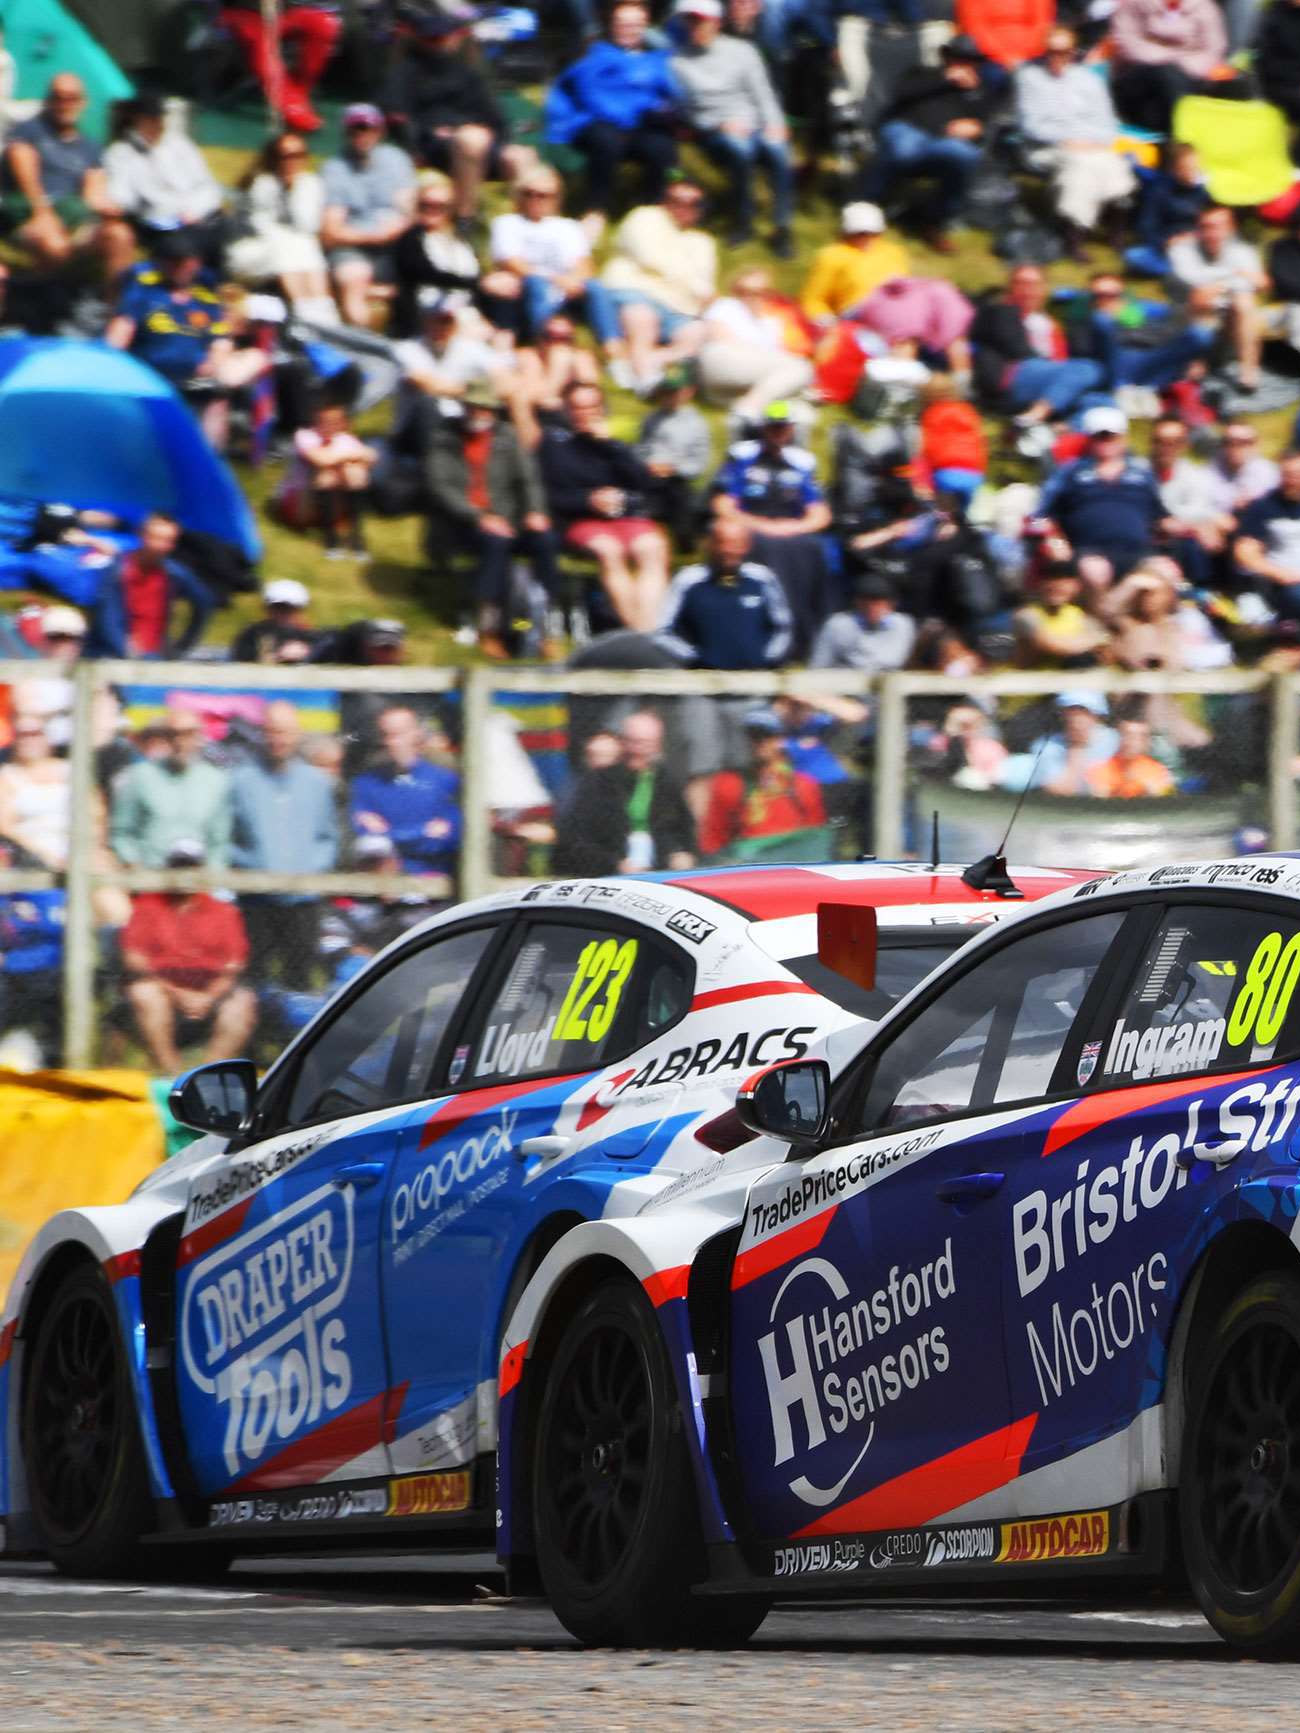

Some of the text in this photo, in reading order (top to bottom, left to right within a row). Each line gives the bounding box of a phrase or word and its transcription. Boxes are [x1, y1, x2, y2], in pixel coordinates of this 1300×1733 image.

[670, 910, 715, 939] HRX
[551, 938, 638, 1042] 123
[474, 1016, 557, 1077] Lloyd
[616, 1026, 818, 1096] ABRACS
[1103, 1016, 1227, 1080] Ingram
[752, 1129, 945, 1237] TradePriceCars.com
[1013, 1098, 1203, 1298] Bristol
[197, 1210, 338, 1367] DRAPER
[808, 1237, 956, 1372] Hansford
[1026, 1252, 1168, 1407] Motors
[823, 1326, 950, 1434] Sensors
[774, 1545, 831, 1576] DRIVEN
[834, 1538, 866, 1561] Purple
[886, 1533, 922, 1556] CREDO
[945, 1527, 994, 1560] SCORPION
[1003, 1515, 1106, 1561] AUTOCAR
